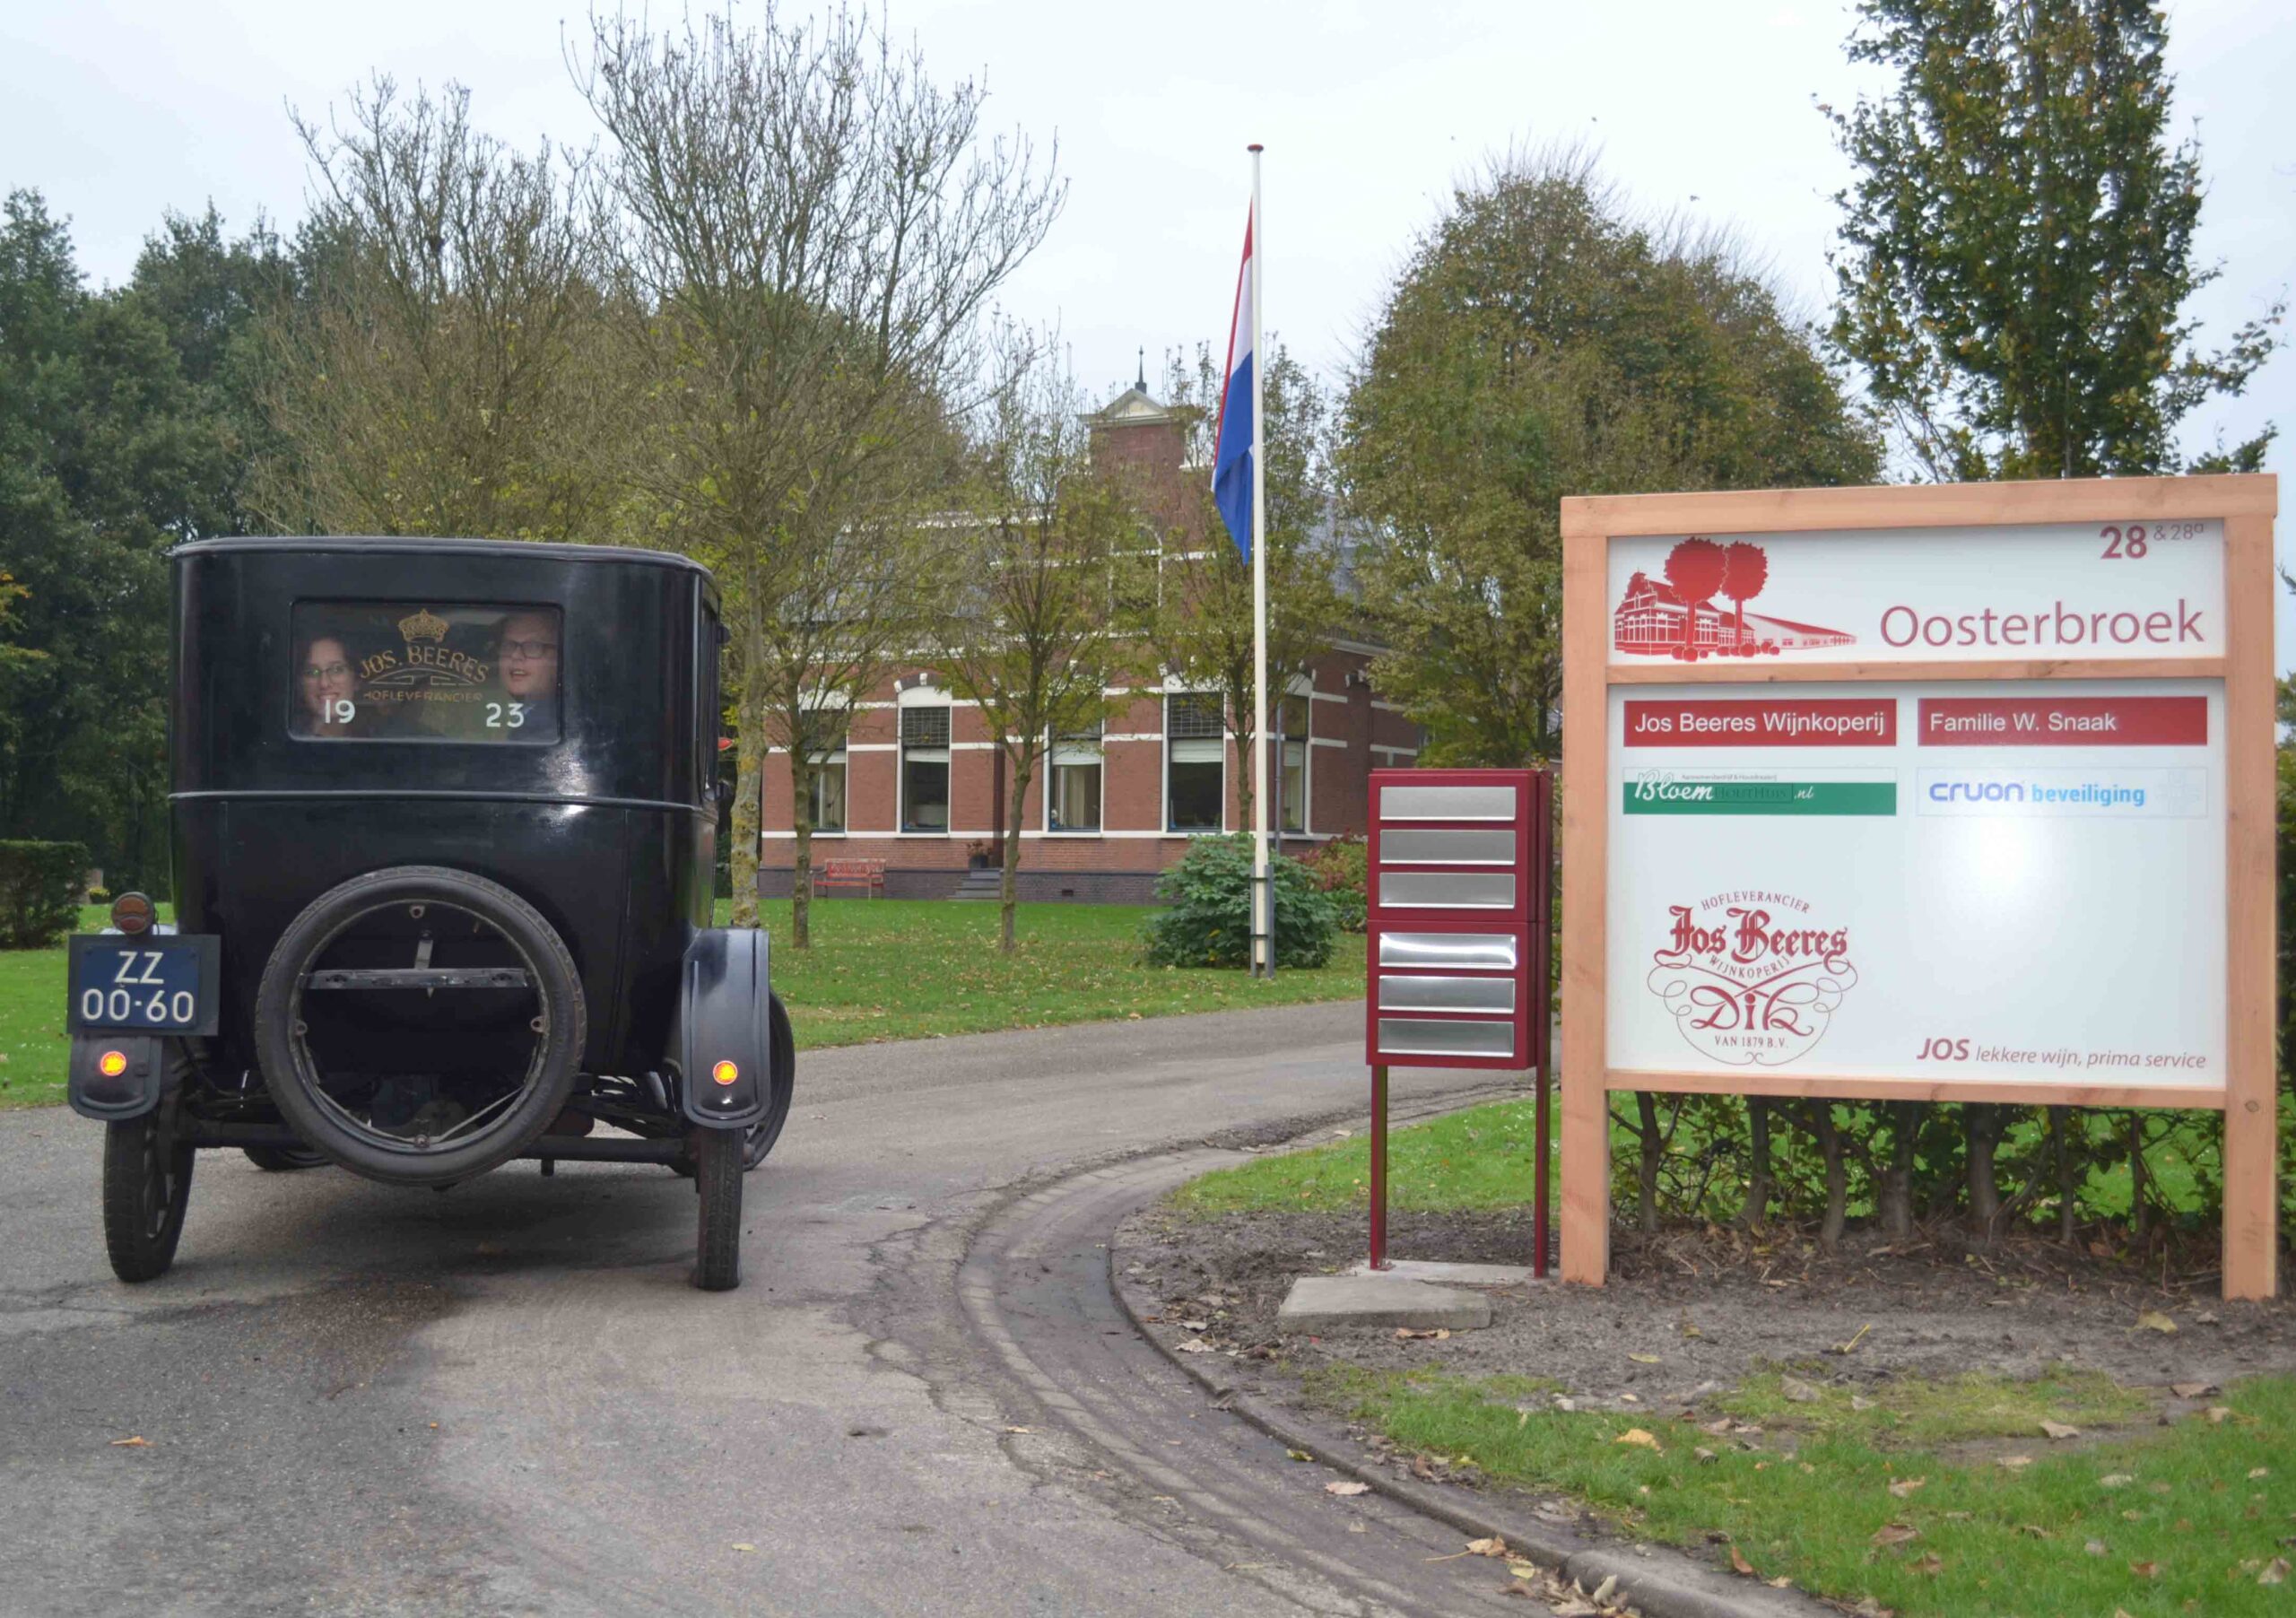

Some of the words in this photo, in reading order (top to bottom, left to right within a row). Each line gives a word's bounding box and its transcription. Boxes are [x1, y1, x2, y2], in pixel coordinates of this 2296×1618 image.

[2100, 526, 2148, 559] 28
[2153, 525, 2167, 541] &
[1880, 598, 2205, 648] Oosterbroek
[361, 649, 403, 679] JOS.
[407, 645, 490, 683] BEERES
[324, 699, 356, 724] 19
[485, 702, 525, 727] 23
[1635, 713, 1672, 733] Jos
[1680, 713, 1756, 733] Beeres
[1763, 711, 1885, 736] Wijnkoperij
[1930, 712, 2006, 731] Familie
[2013, 713, 2039, 731] W.
[2048, 712, 2117, 731] Snaak
[1634, 768, 1714, 801] Bloem
[1794, 786, 1814, 800] .nl
[1929, 782, 2024, 802] cruon
[2031, 783, 2146, 807] beveiliging
[1700, 891, 1810, 913] HOFLEVERANCIER
[1654, 905, 1727, 969] Jos
[1726, 907, 1850, 974] Beeres
[114, 951, 165, 985] ZZ
[1709, 954, 1791, 979] WIJNKOPERIJ
[83, 988, 195, 1023] 00-60
[1715, 1035, 1738, 1048] VAN
[1742, 1036, 1764, 1048] 1879
[1767, 1037, 1789, 1049] B.V.
[1917, 1038, 1970, 1061] JOS
[1976, 1045, 2038, 1064] lekkere
[2041, 1047, 2083, 1069] wijn,
[2087, 1049, 2141, 1070] prima
[2144, 1051, 2206, 1069] service
